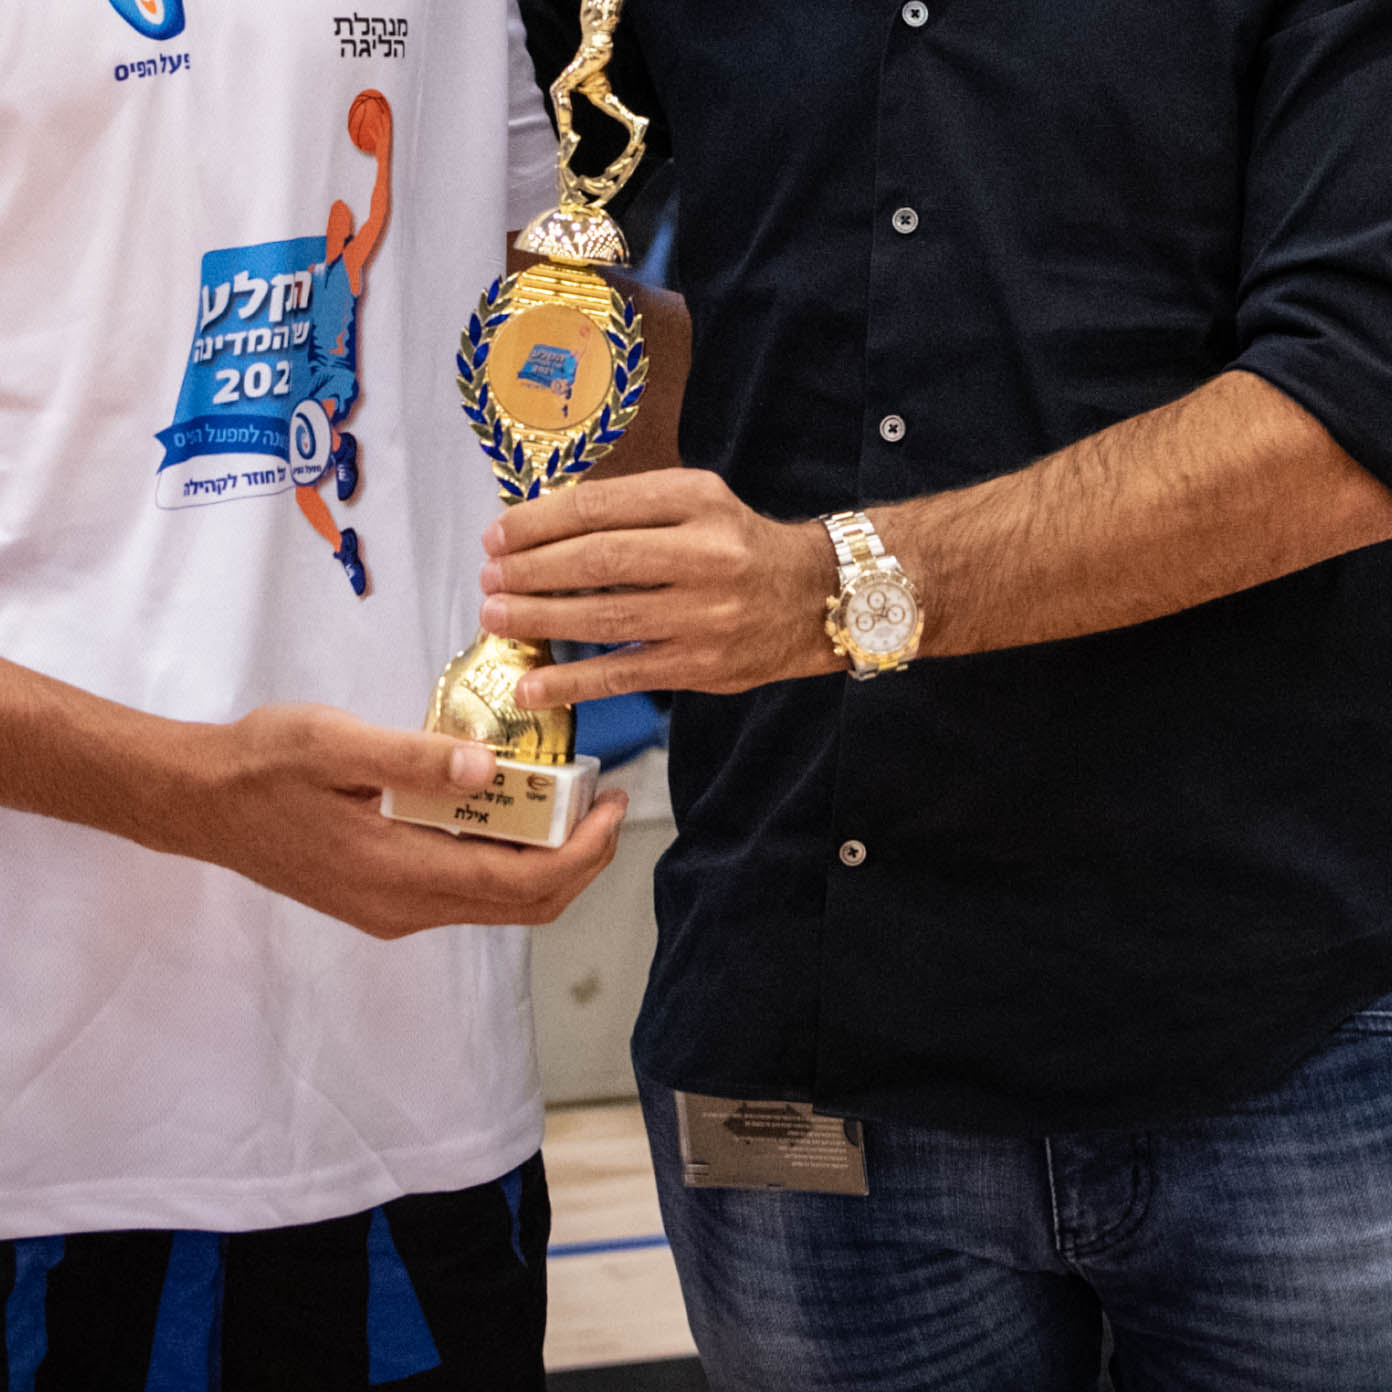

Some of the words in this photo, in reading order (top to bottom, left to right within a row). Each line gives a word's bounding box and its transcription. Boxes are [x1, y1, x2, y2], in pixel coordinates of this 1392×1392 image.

[333, 12, 409, 38] מנהלת
[340, 35, 407, 59] הליגה
[159, 52, 192, 75] פעל
[193, 323, 290, 364] המדינה
[211, 360, 293, 406] 202
[205, 422, 260, 445] למפעל
[240, 468, 276, 487] חוזר
[454, 803, 490, 823] אילת
